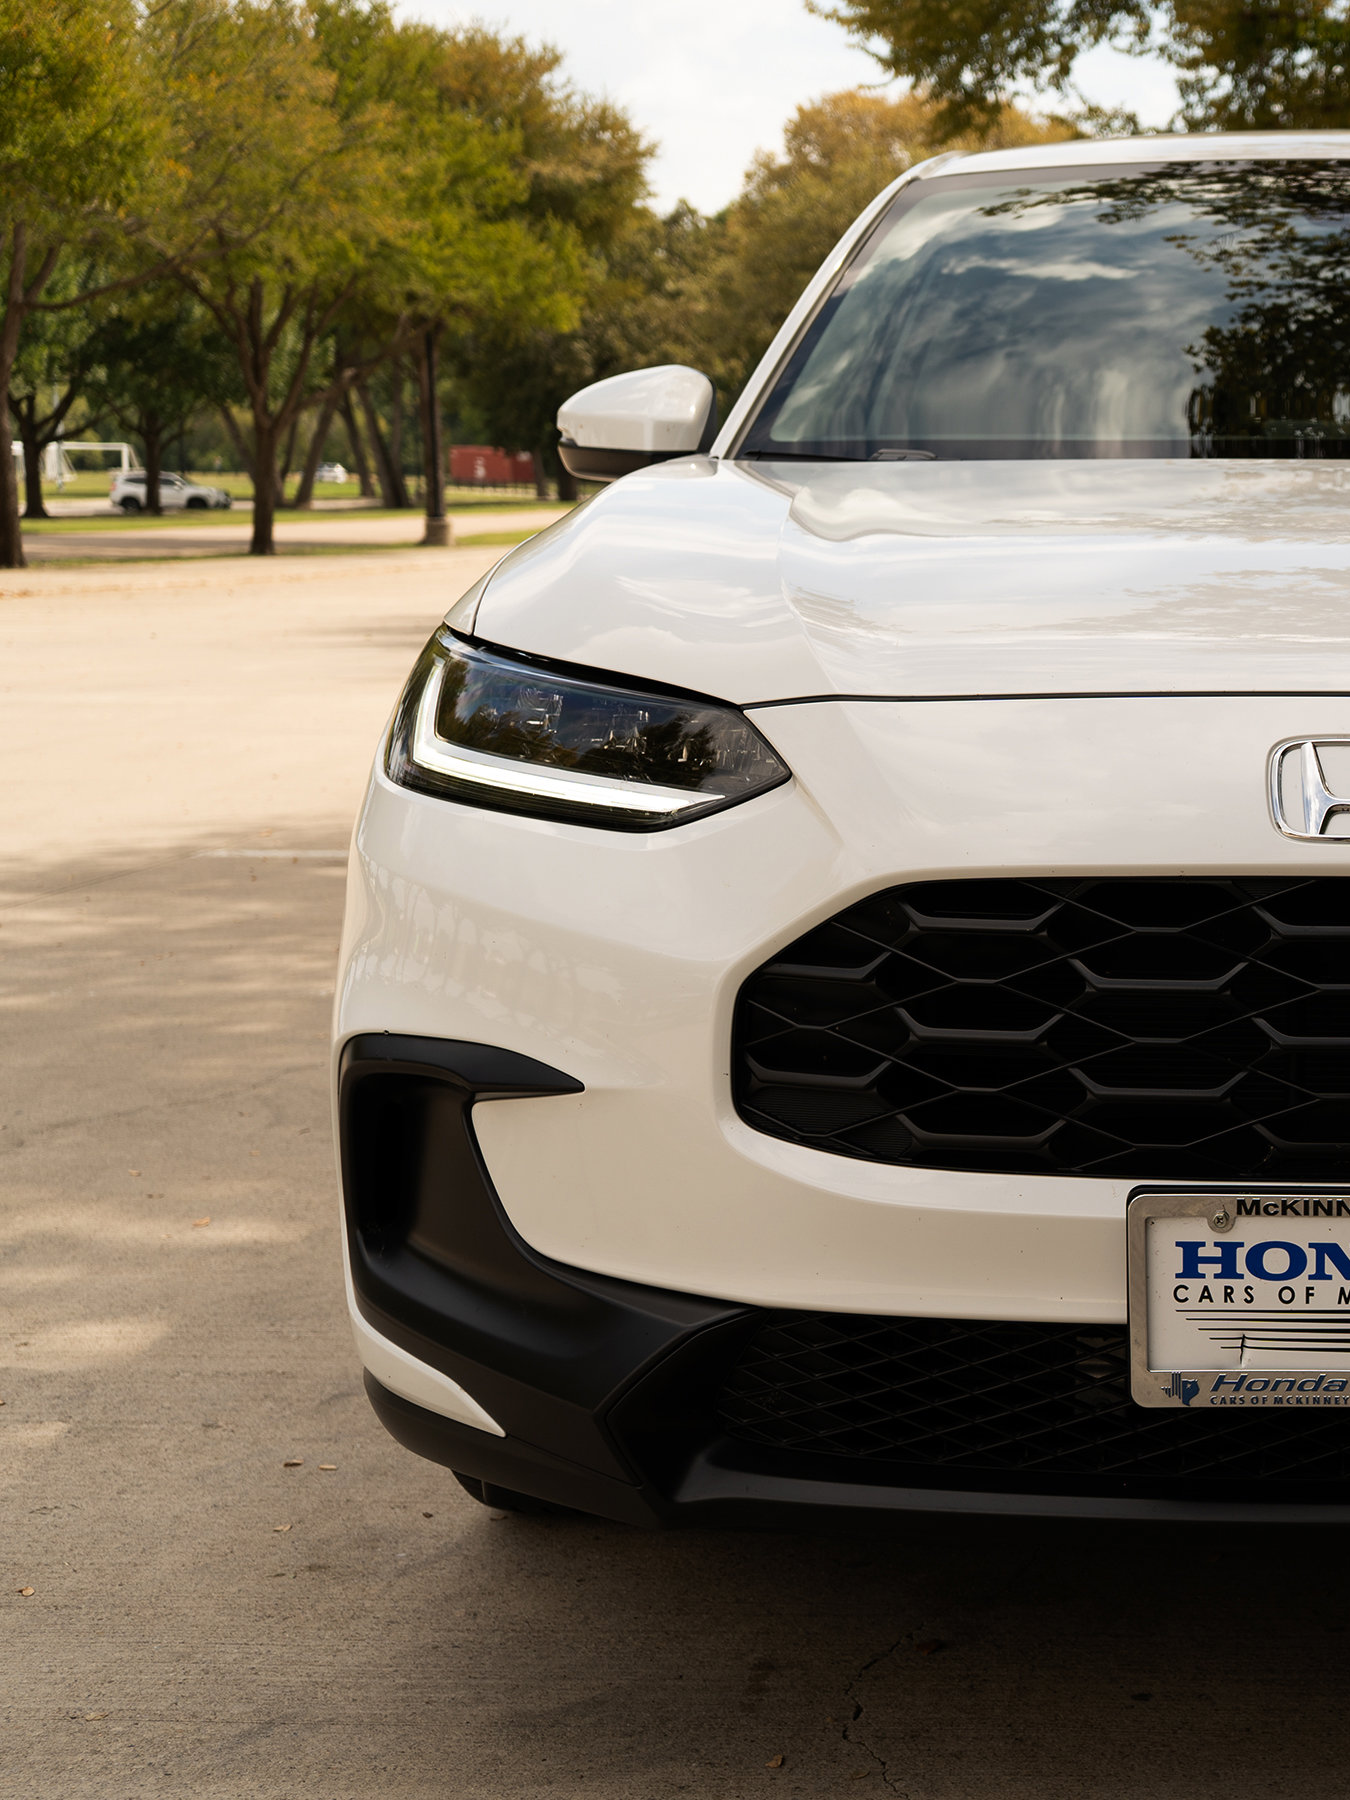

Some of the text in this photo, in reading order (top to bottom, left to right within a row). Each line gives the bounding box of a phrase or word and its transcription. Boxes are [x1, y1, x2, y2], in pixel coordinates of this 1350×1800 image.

[1173, 1284, 1254, 1304] CARS
[1278, 1286, 1315, 1305] OF
[1210, 1373, 1349, 1393] Honda
[1210, 1395, 1350, 1406] CARS OF MCKINNEY
